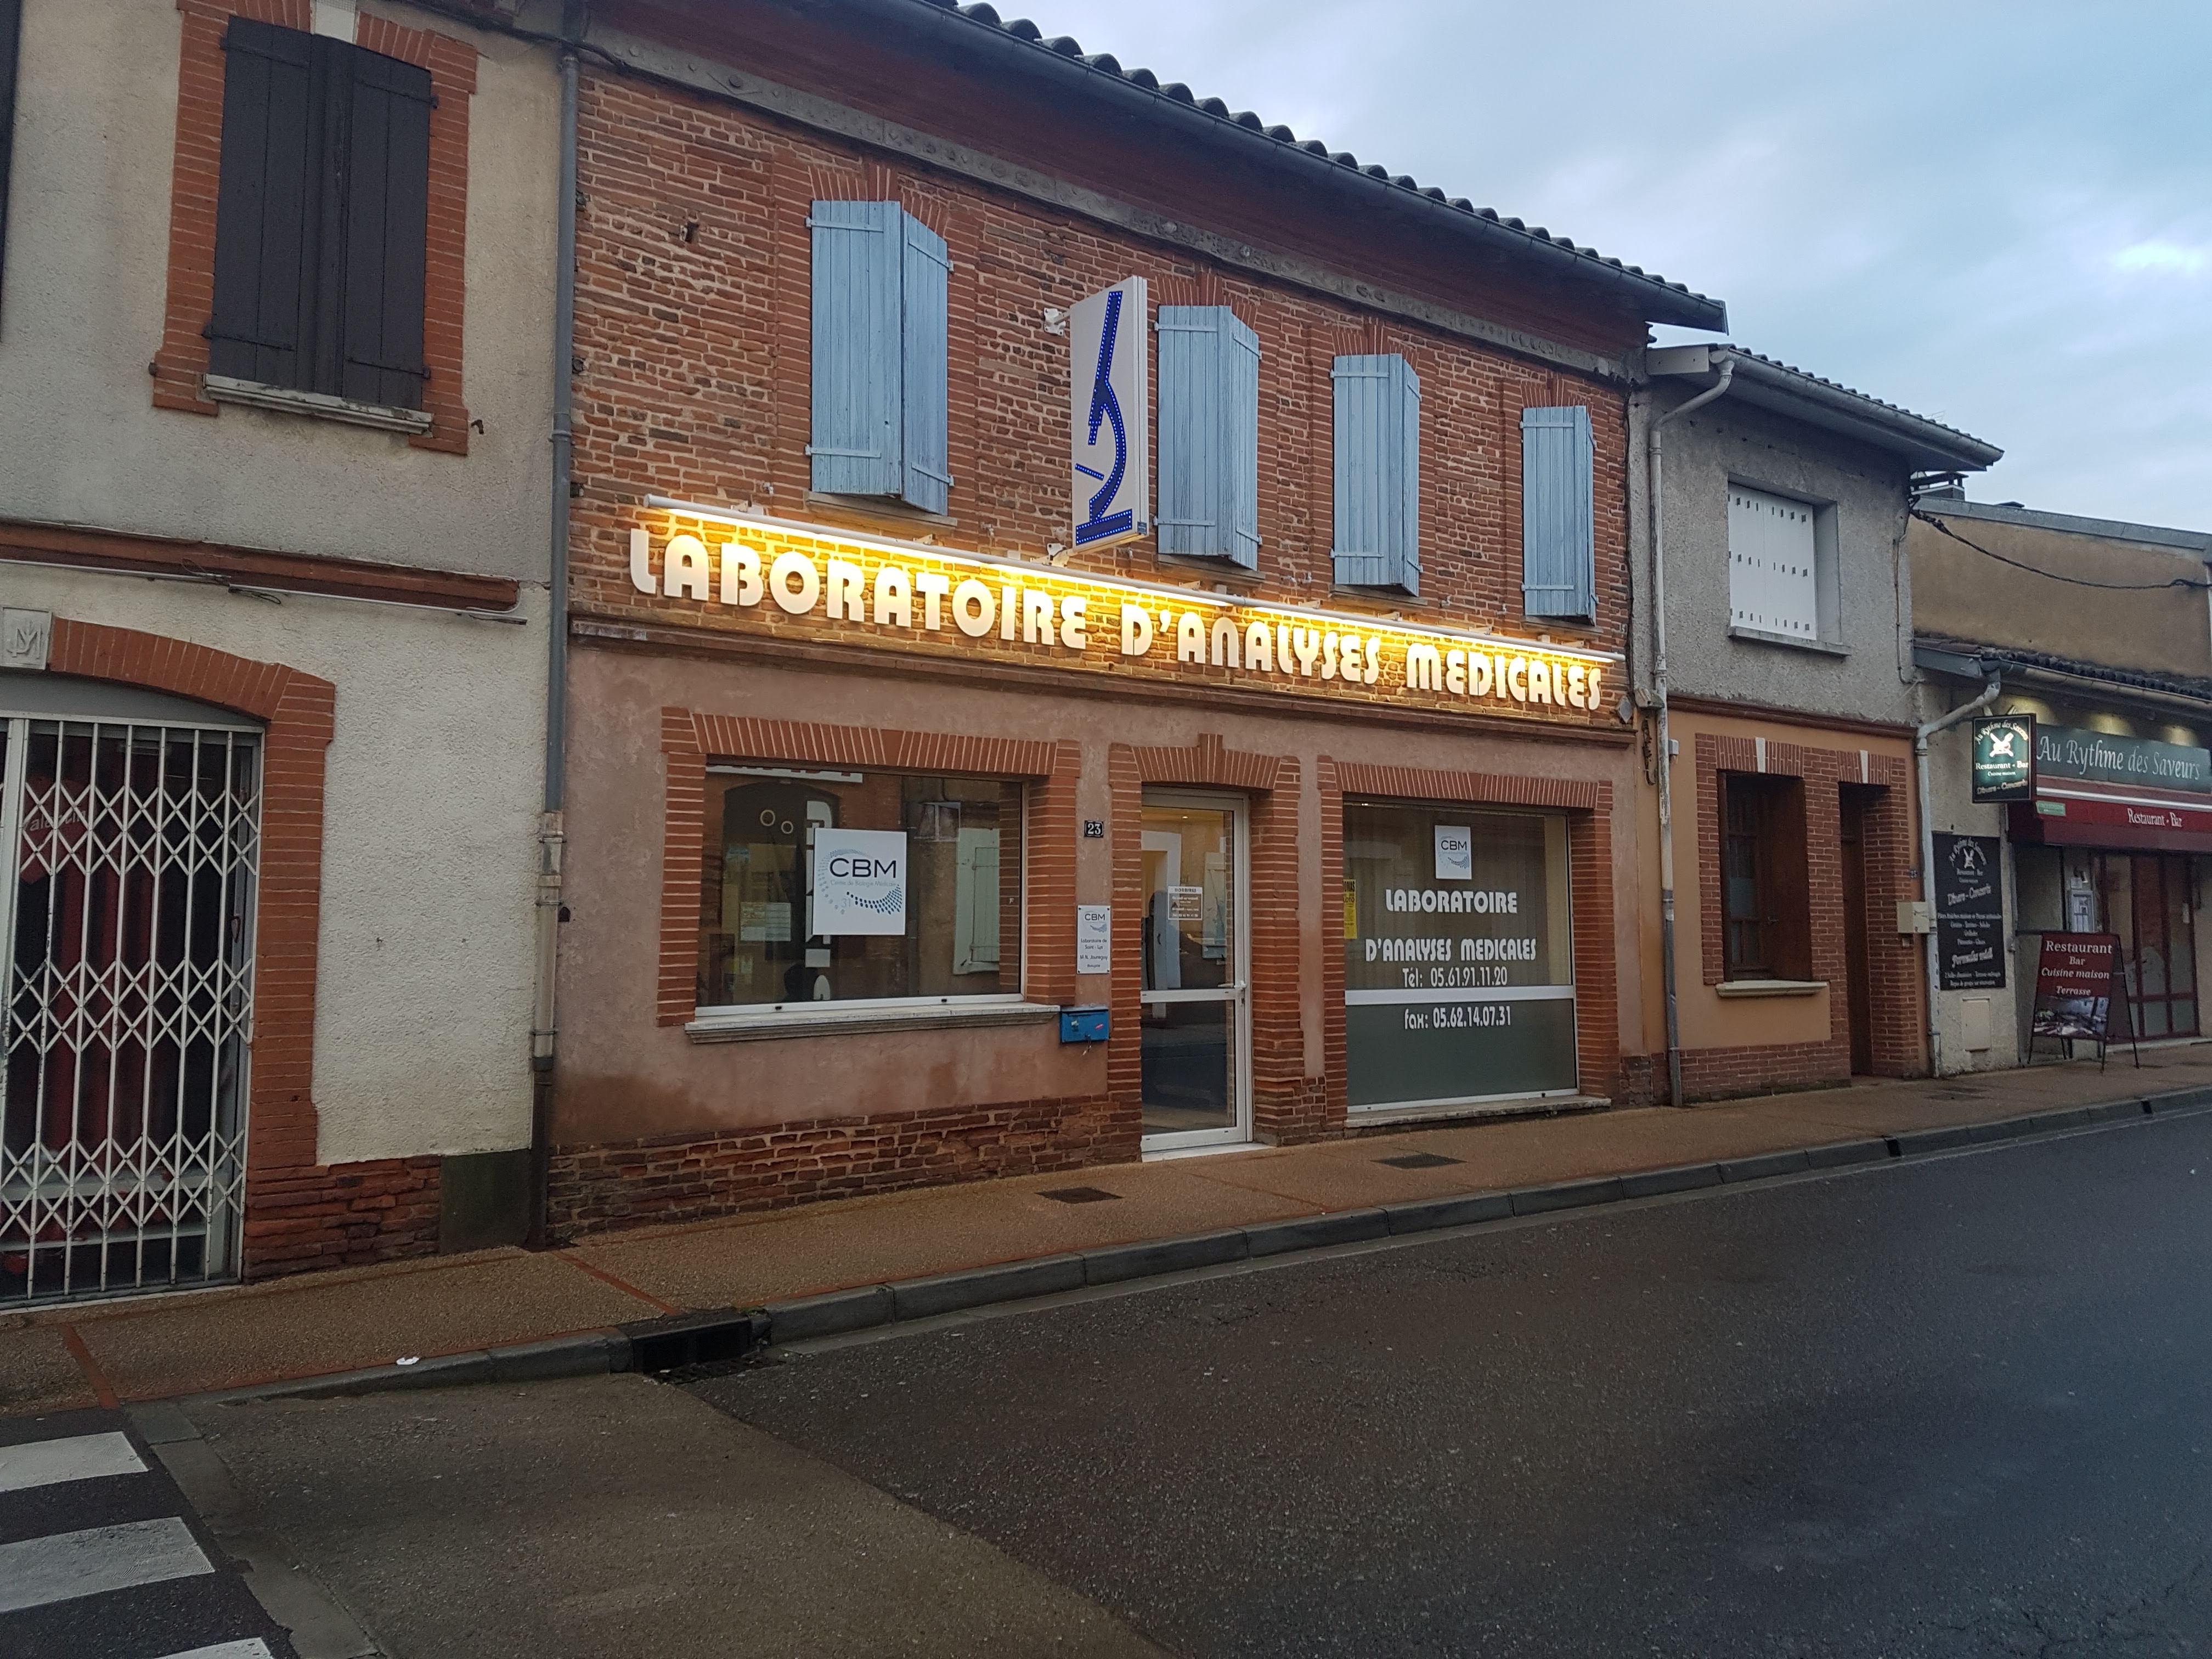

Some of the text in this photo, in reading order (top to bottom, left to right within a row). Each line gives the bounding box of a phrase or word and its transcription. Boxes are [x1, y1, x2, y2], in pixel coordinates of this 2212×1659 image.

[630, 527, 1601, 710] LABORATOIRE D'ANALYSES MEDICALES
[1976, 762, 2011, 770] Restaurant
[2017, 760, 2029, 769] Bar
[2036, 736, 2200, 780] Au Rythme des Saveurs
[2127, 808, 2165, 826] Restaurant
[2170, 812, 2182, 827] Bar
[1087, 823, 1101, 834] 23
[1440, 840, 1468, 851] CBM
[830, 857, 896, 878] CBM
[1386, 889, 1517, 913] LABORATOIRE
[1365, 938, 1536, 962] D'ANALYSES MEDICALES
[2045, 940, 2112, 954] Restaurant
[2069, 956, 2085, 965] Bar
[1402, 966, 1508, 988] Tél: 05.61.91.11.20
[2041, 967, 2109, 979] Cuisine maison
[2056, 986, 2091, 996] Terrasse
[1433, 1006, 1511, 1028] 05.62.14.07.31
